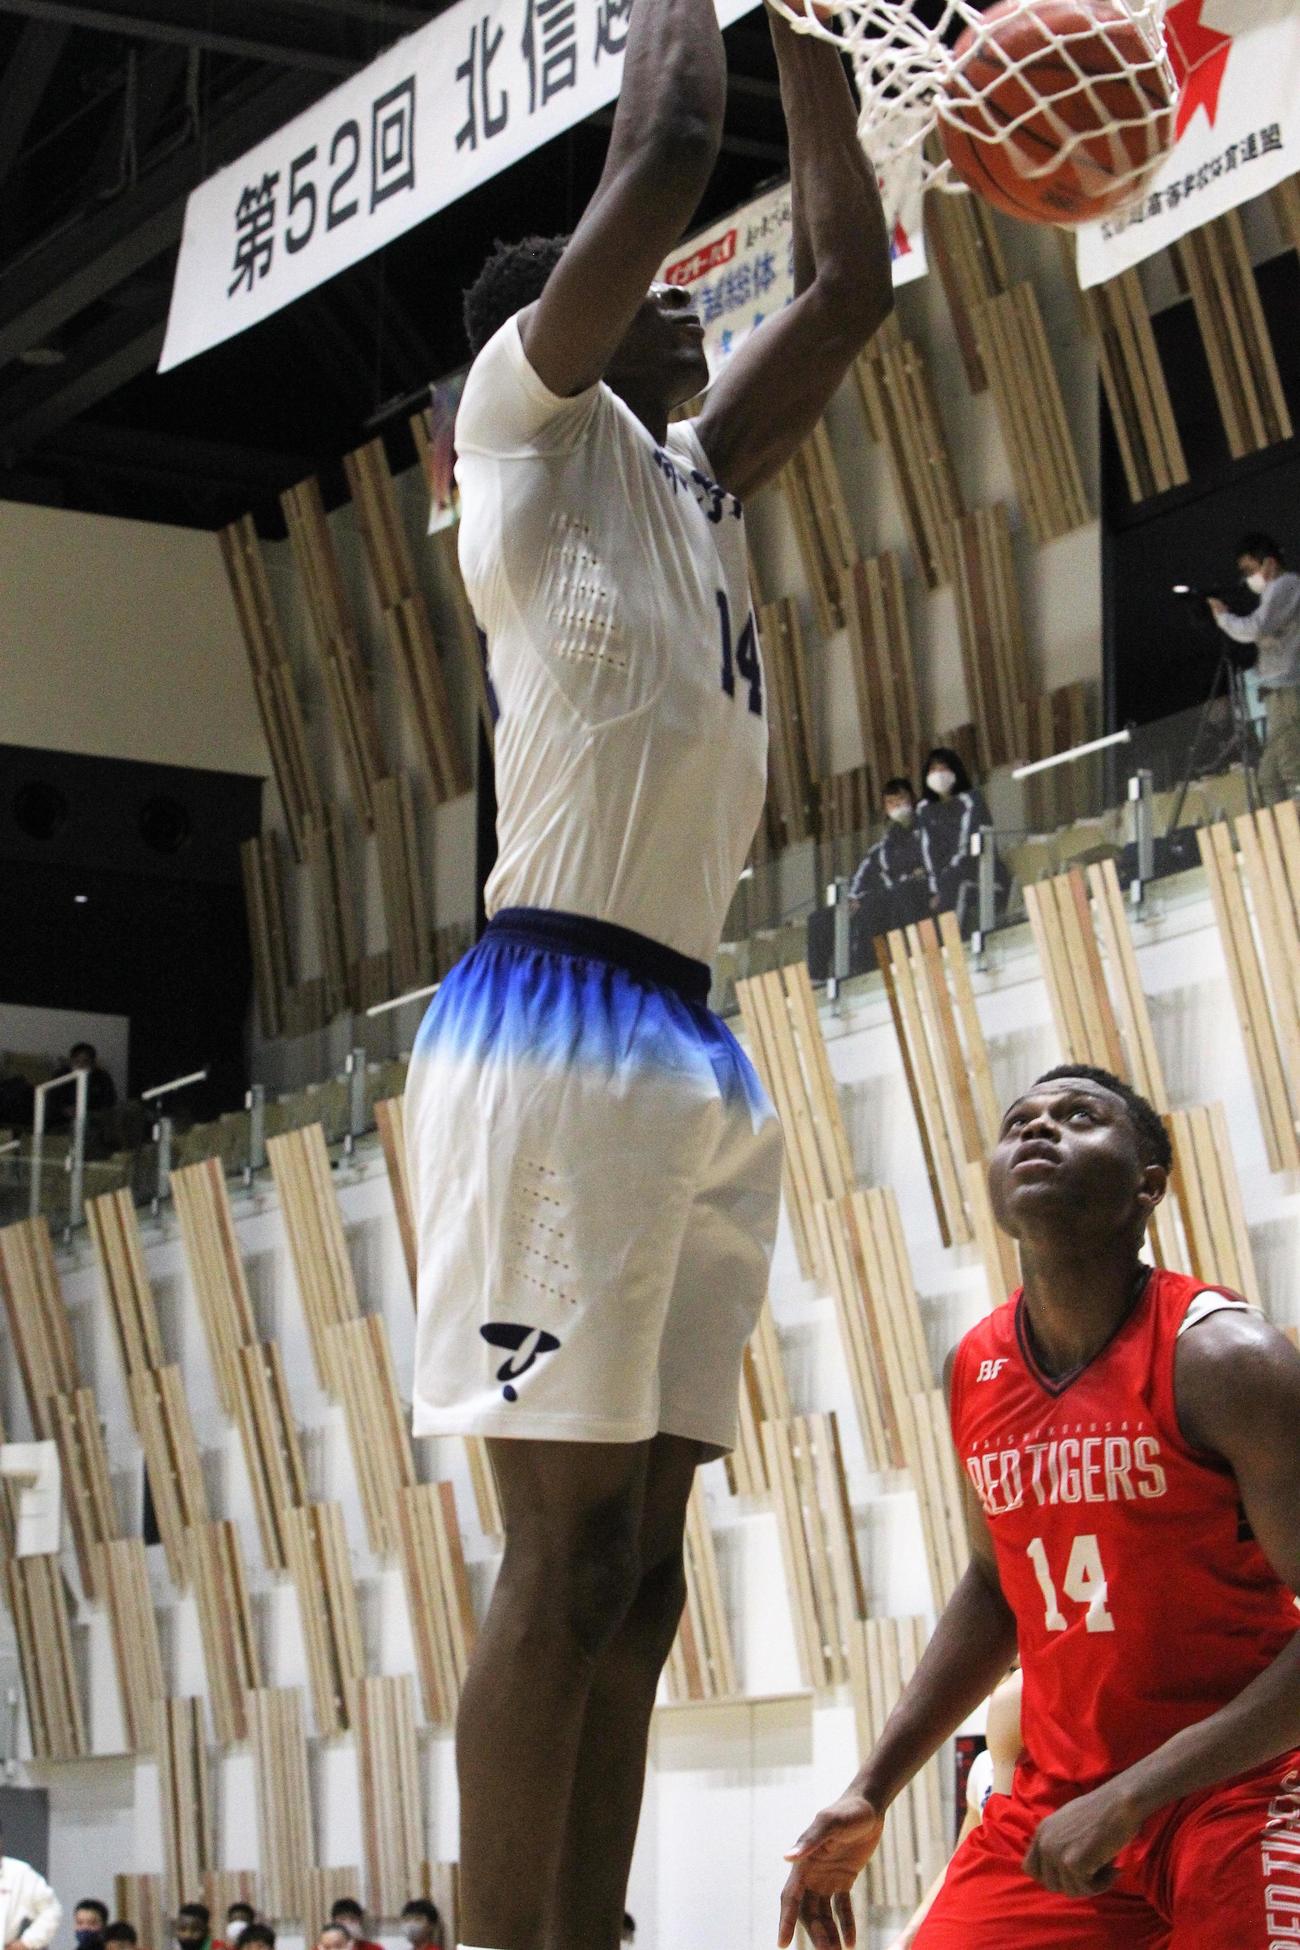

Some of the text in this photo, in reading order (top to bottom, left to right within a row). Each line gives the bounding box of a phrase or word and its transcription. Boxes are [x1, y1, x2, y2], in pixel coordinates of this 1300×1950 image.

[227, 74, 417, 299] 第52回
[977, 1358, 1009, 1383] BF
[966, 1436, 1168, 1515] RED TIGERS
[1026, 1533, 1115, 1633] 14
